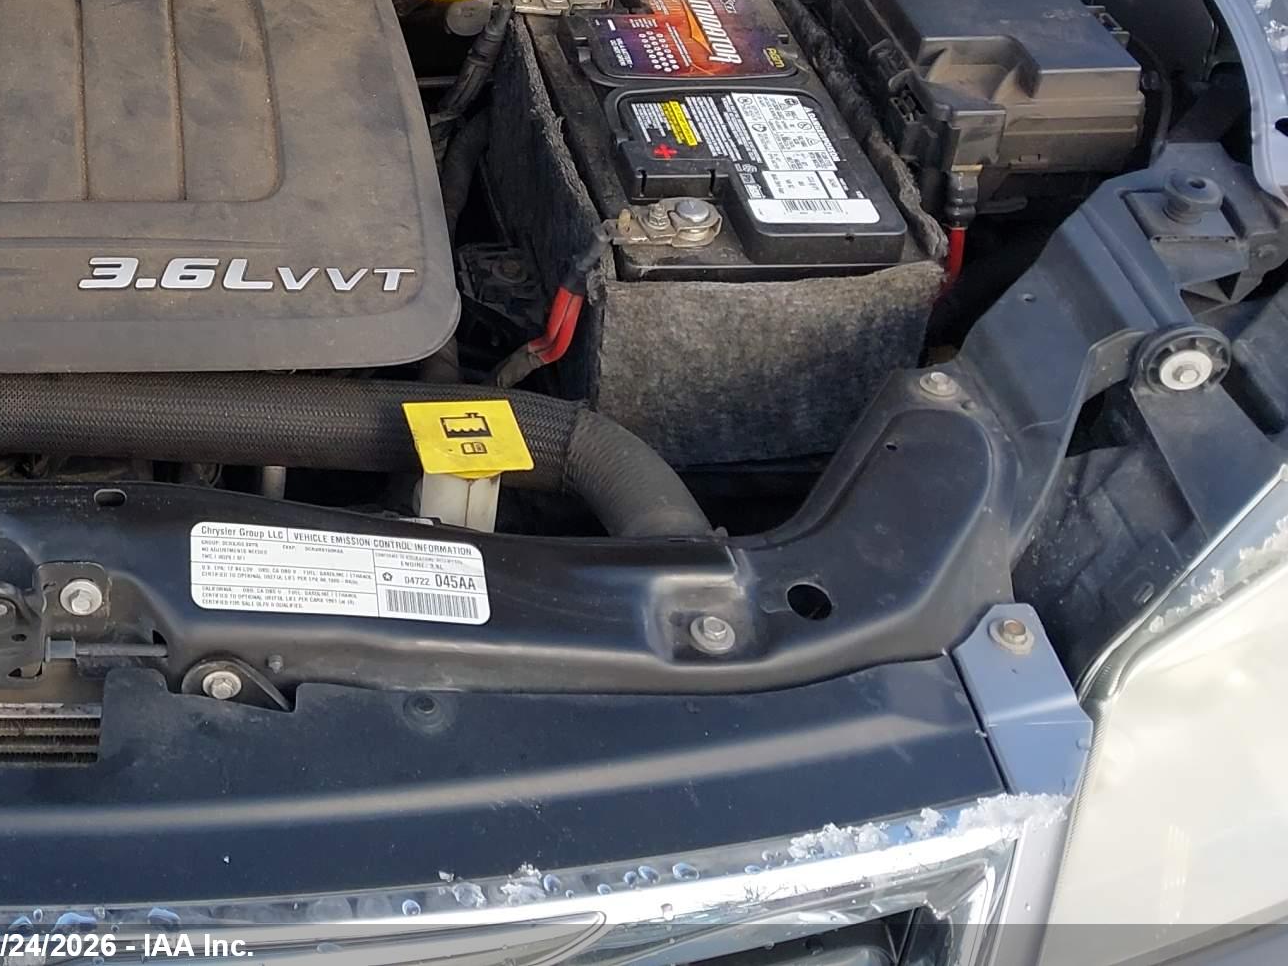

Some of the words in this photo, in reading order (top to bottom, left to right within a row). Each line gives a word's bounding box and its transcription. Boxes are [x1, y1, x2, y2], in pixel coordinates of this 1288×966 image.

[767, 47, 786, 68] AGM
[78, 256, 274, 290] 3.6L
[276, 266, 416, 291] VVT
[201, 525, 237, 538] Chrysler
[239, 528, 263, 540] Group
[267, 530, 284, 540] LLC
[293, 532, 328, 544] VEHICLE
[330, 535, 371, 547] EMISSION
[373, 539, 411, 551] CONTROL
[414, 543, 472, 555] INFORMATION
[404, 576, 430, 586] 04722
[434, 574, 477, 591] 045AA
